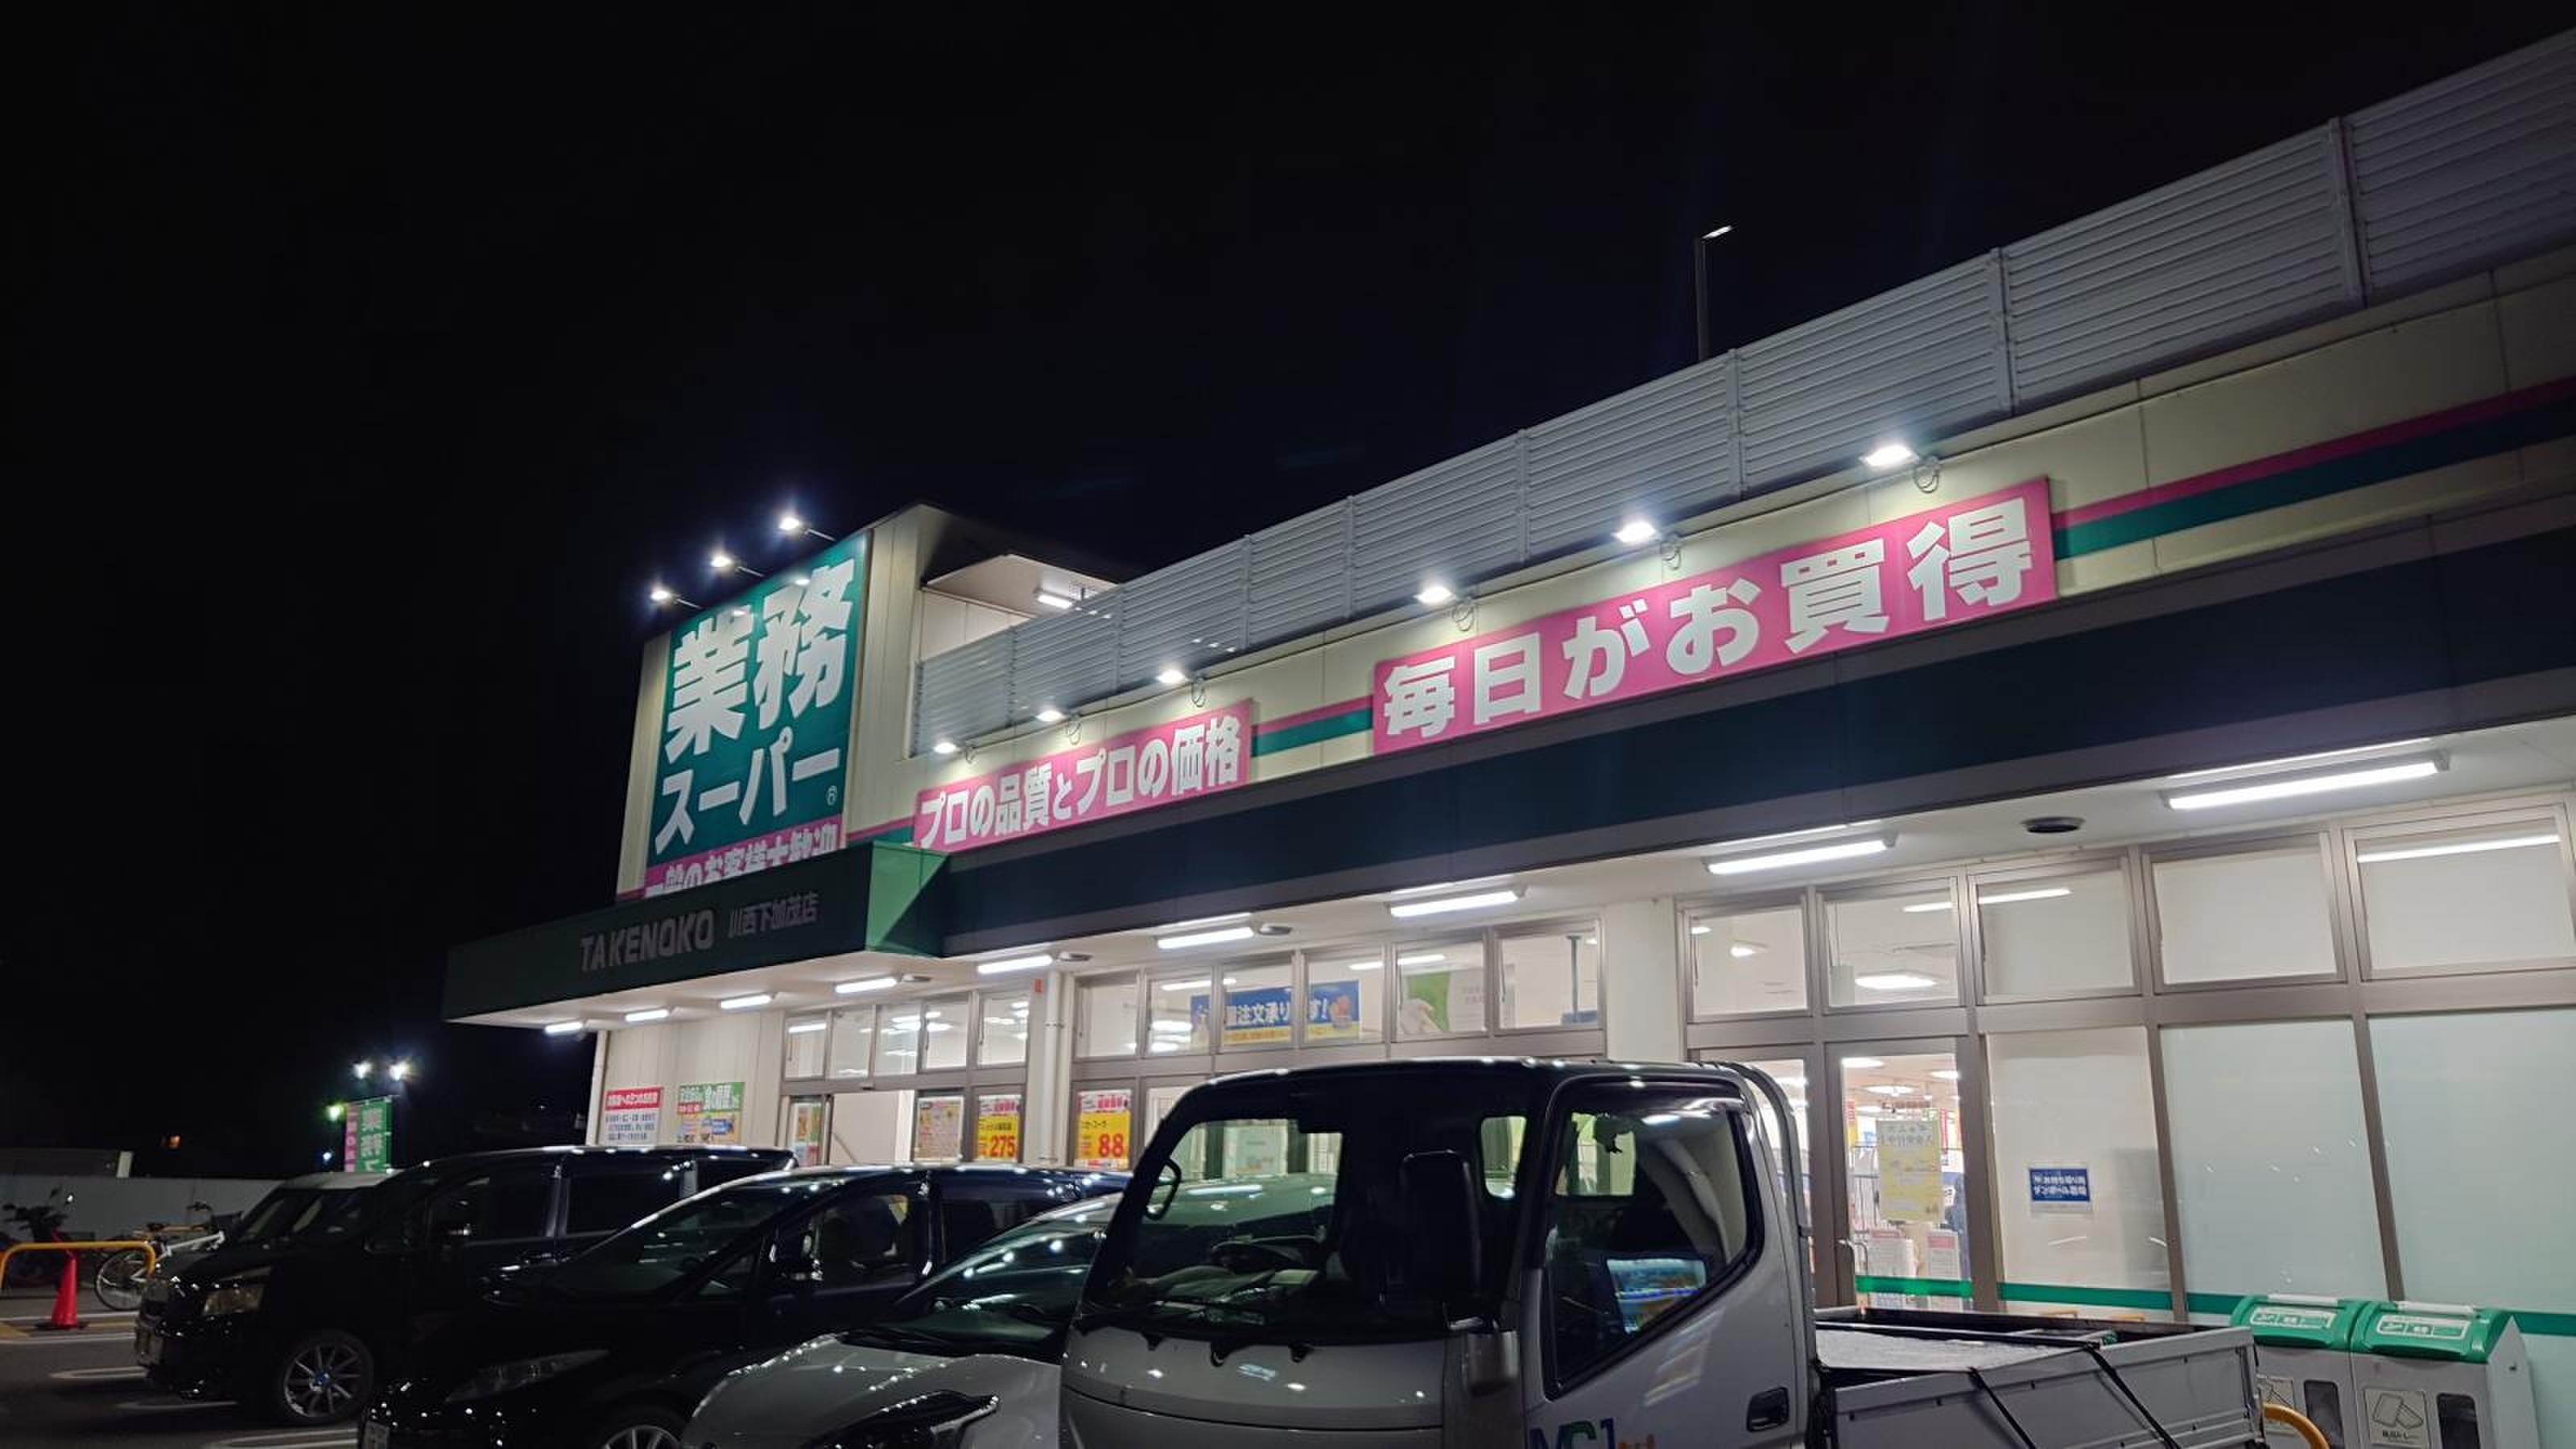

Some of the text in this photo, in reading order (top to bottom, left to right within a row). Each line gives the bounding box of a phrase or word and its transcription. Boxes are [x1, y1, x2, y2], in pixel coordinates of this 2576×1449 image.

[665, 558, 855, 764] 業務
[1383, 496, 2032, 739] 毎日がお買得
[654, 726, 840, 855] スーパー
[919, 715, 1241, 849] プロの品質とプロの価格
[580, 909, 715, 972] TAKENOKO
[989, 1133, 1015, 1158] 275
[1098, 1133, 1125, 1158] 88
